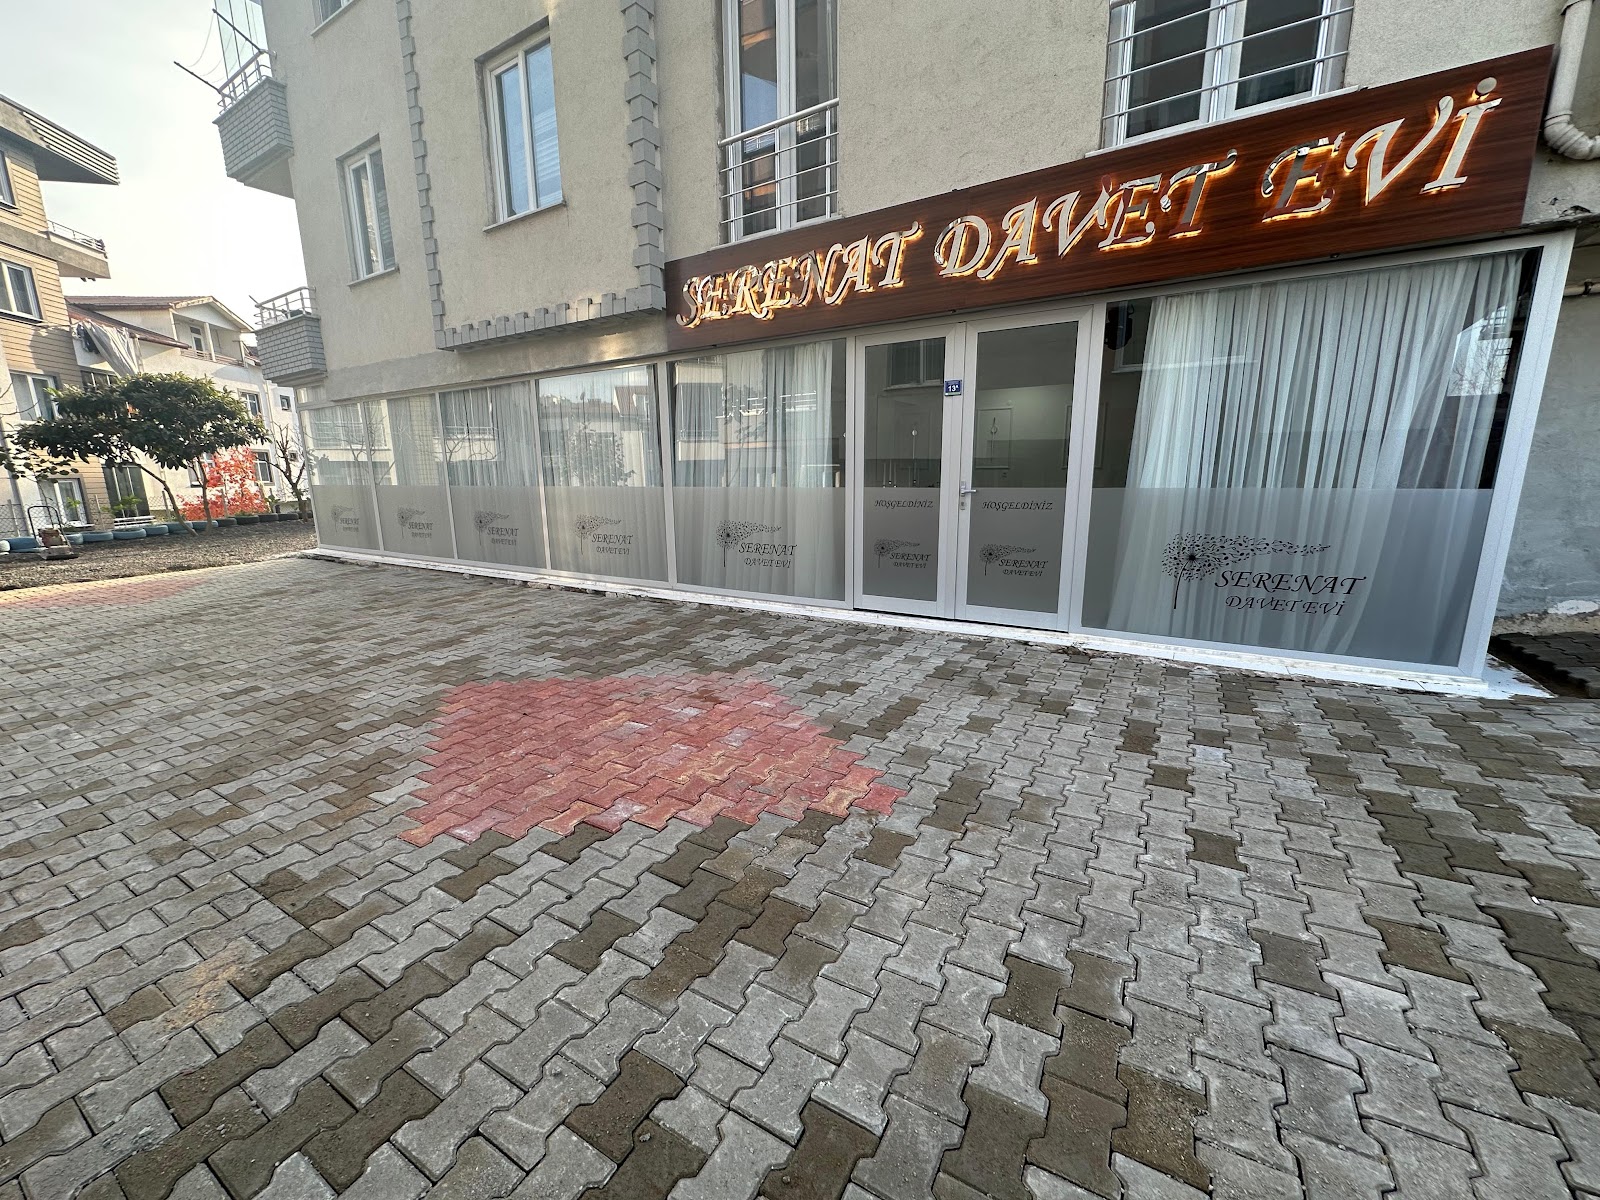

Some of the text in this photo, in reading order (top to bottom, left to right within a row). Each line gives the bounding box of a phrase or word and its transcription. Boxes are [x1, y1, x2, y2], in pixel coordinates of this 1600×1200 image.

[676, 76, 1503, 328] SERENAT DAVET EVİ
[982, 500, 1053, 512] HOŞGELDİNİZ
[407, 521, 434, 531] SERENAT
[486, 526, 519, 537] SERENAT
[591, 533, 634, 545] SERENAT
[738, 542, 798, 556] SERENAT
[744, 558, 775, 567] DAVET
[889, 552, 932, 562] SERENAT
[998, 558, 1049, 569] SERENAT
[1214, 569, 1367, 595] SERENAT
[1225, 595, 1303, 613] DAVET
